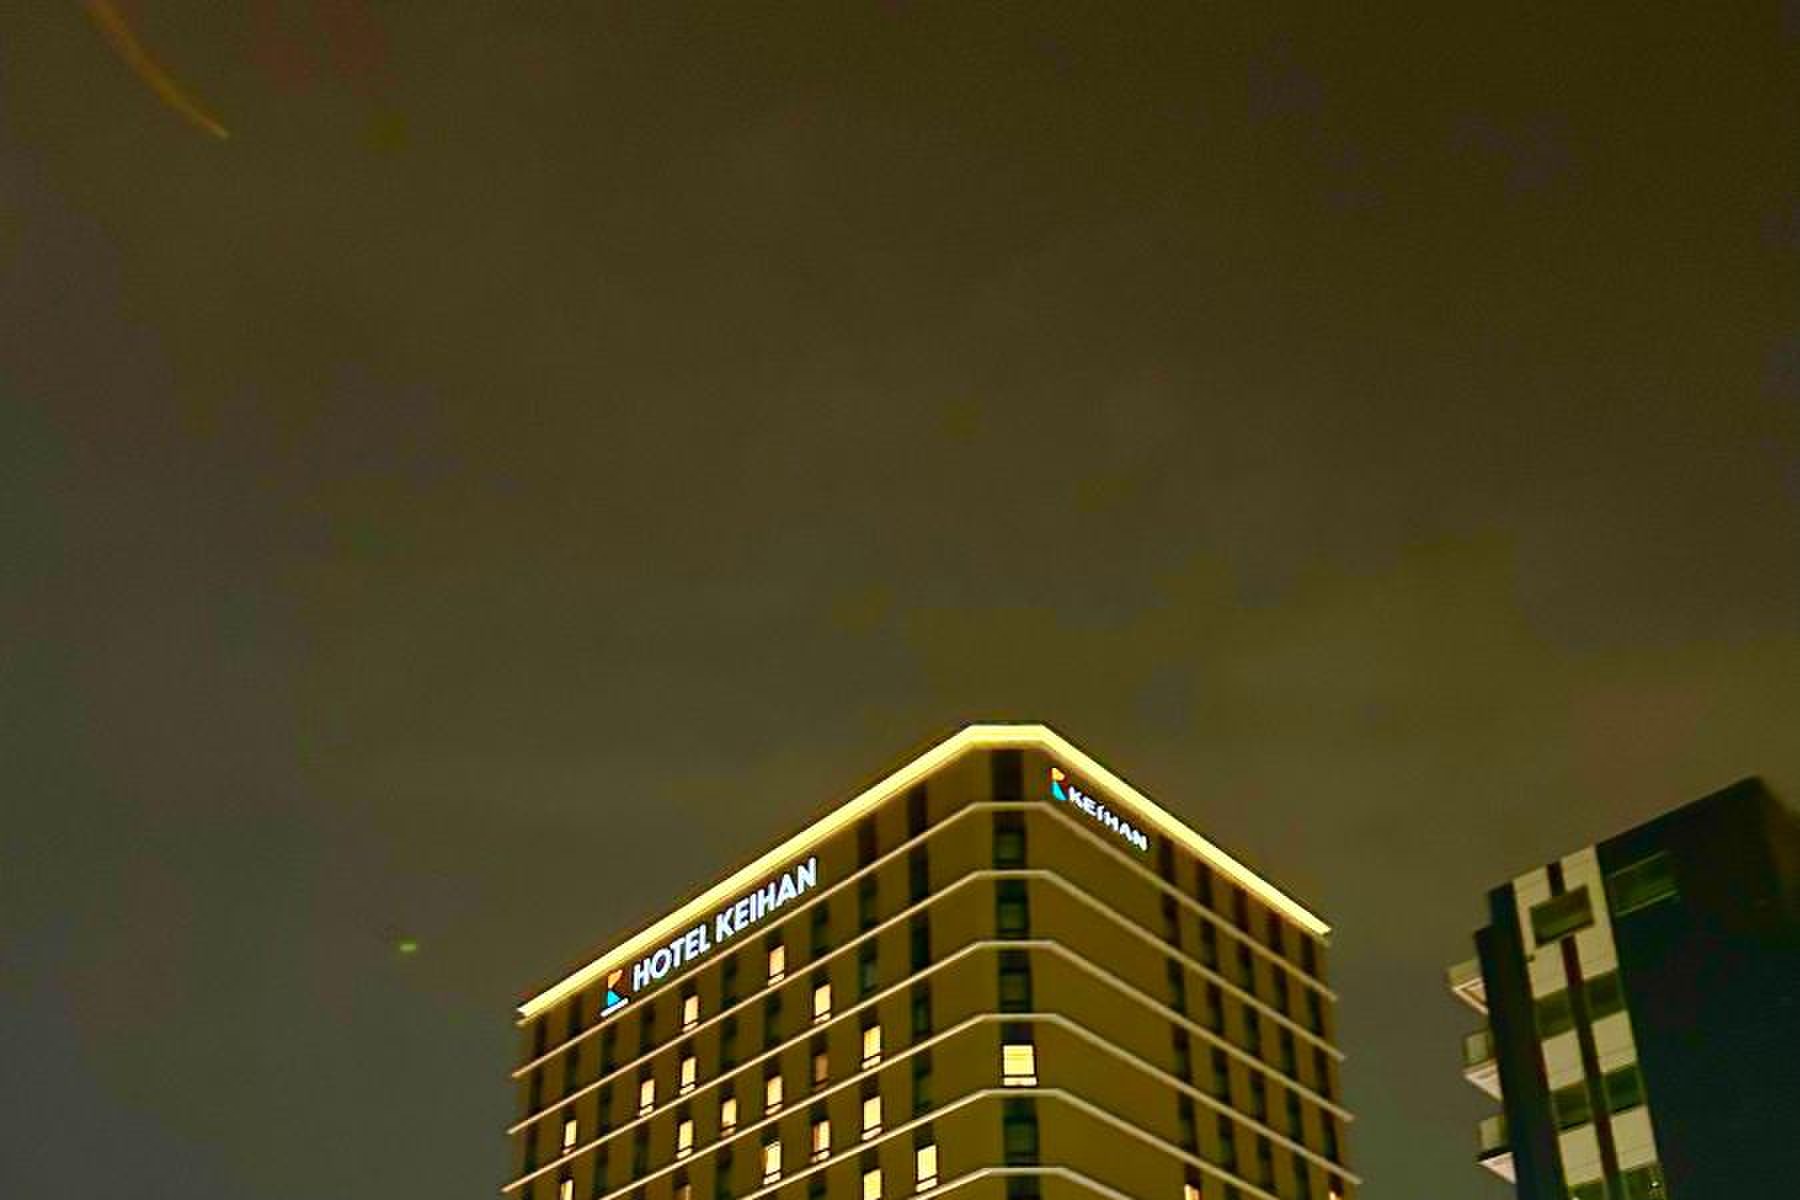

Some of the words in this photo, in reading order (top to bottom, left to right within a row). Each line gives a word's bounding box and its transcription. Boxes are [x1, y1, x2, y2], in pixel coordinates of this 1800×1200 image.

[1068, 786, 1148, 851] KEIHAN
[633, 924, 711, 992] HOTEL
[715, 857, 817, 943] KEIHAN
